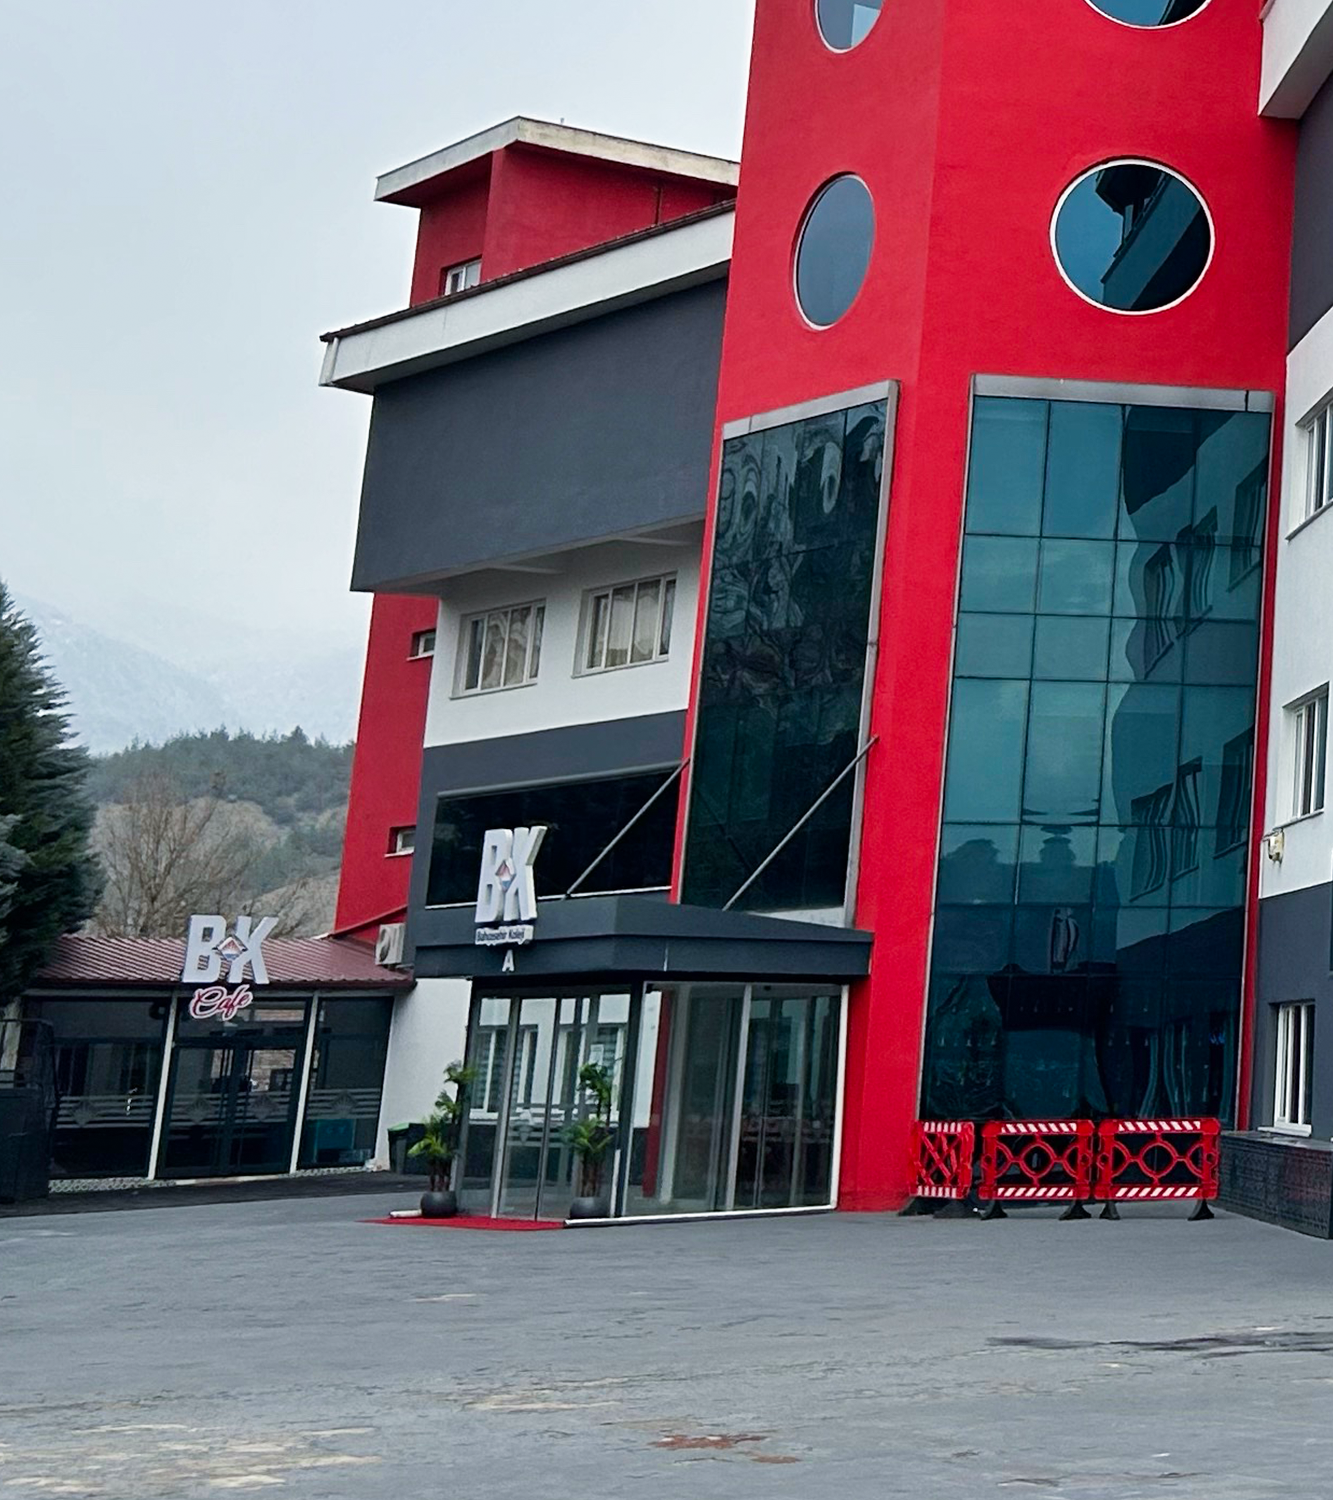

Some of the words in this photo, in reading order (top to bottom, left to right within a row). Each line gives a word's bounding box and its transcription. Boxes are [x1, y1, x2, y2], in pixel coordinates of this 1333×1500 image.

[475, 826, 548, 923] BK
[182, 914, 279, 984] BK
[502, 950, 515, 972] A
[190, 984, 253, 1021] Cafe
